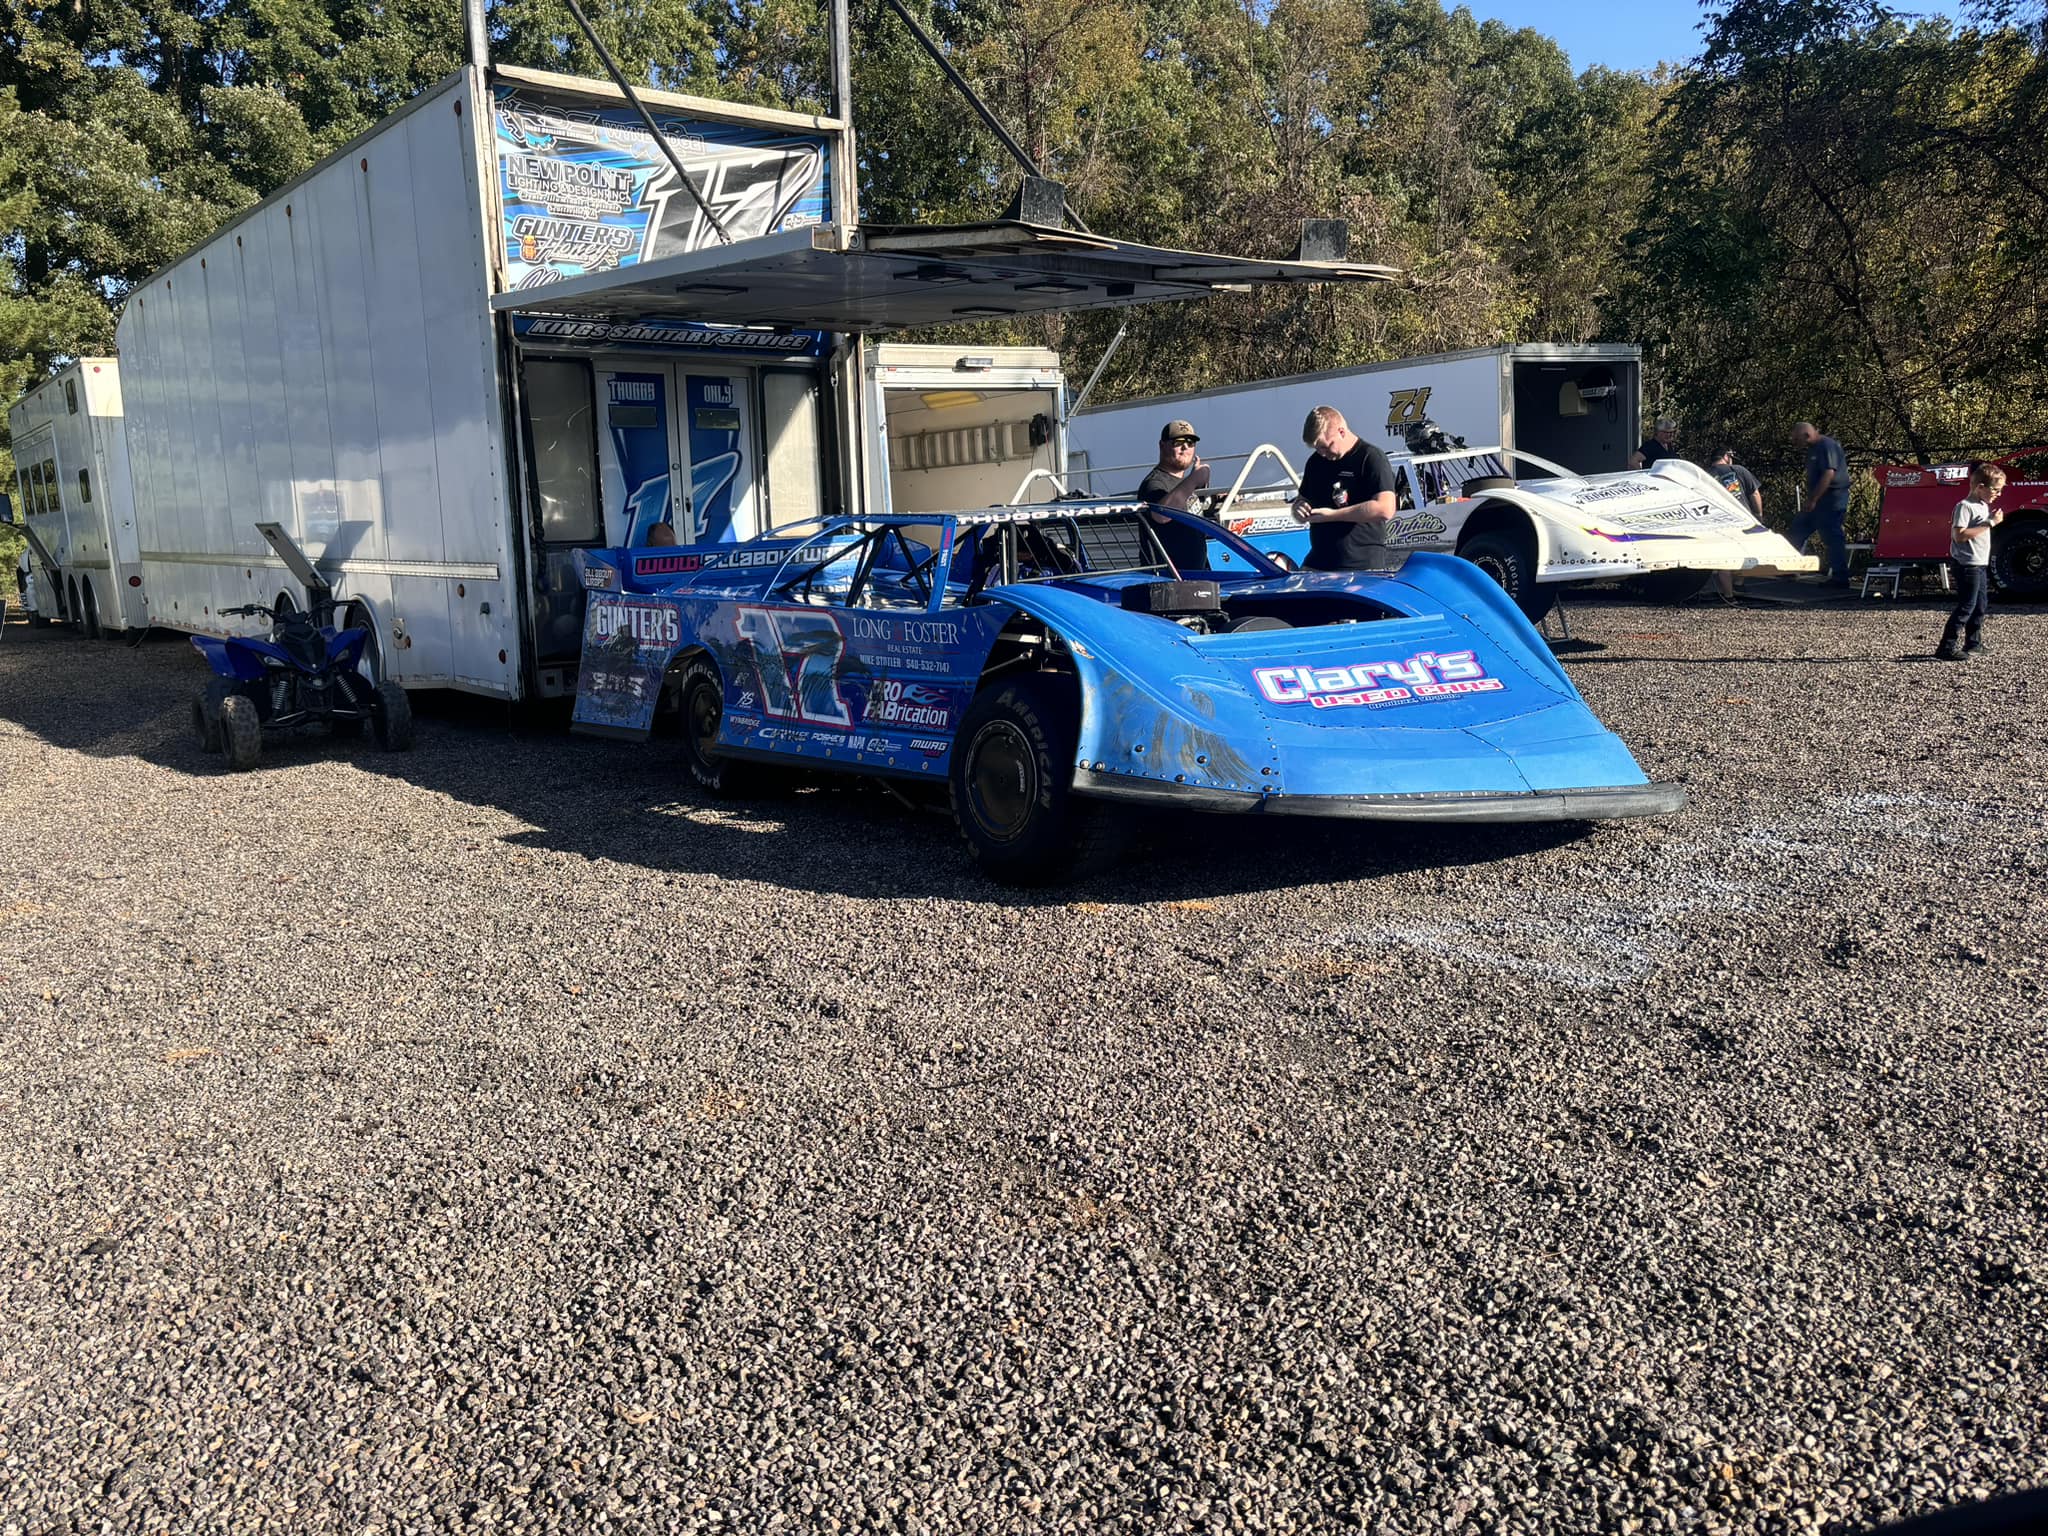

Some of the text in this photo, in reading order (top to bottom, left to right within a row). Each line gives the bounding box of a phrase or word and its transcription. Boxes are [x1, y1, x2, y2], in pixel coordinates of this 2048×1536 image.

[507, 155, 560, 181] NEW
[508, 174, 559, 193] LIGHTING
[514, 217, 629, 247] GUNTER'S
[535, 235, 612, 268] Honey
[531, 320, 808, 349] KINGS SANITARY SERVICE
[1388, 386, 1432, 424] 71
[624, 451, 741, 549] 17
[957, 503, 1145, 525] THUGG NASTY
[1690, 504, 1711, 516] 17
[596, 605, 679, 642] GUNTER'S
[853, 617, 891, 640] LONG
[904, 621, 959, 644] FOSTER
[887, 644, 922, 655] REAL ESTATE
[735, 605, 854, 731] 17
[1255, 652, 1482, 702] Clary's
[736, 691, 755, 707] XS
[1314, 687, 1409, 708] USED
[1415, 678, 1502, 696] CARS
